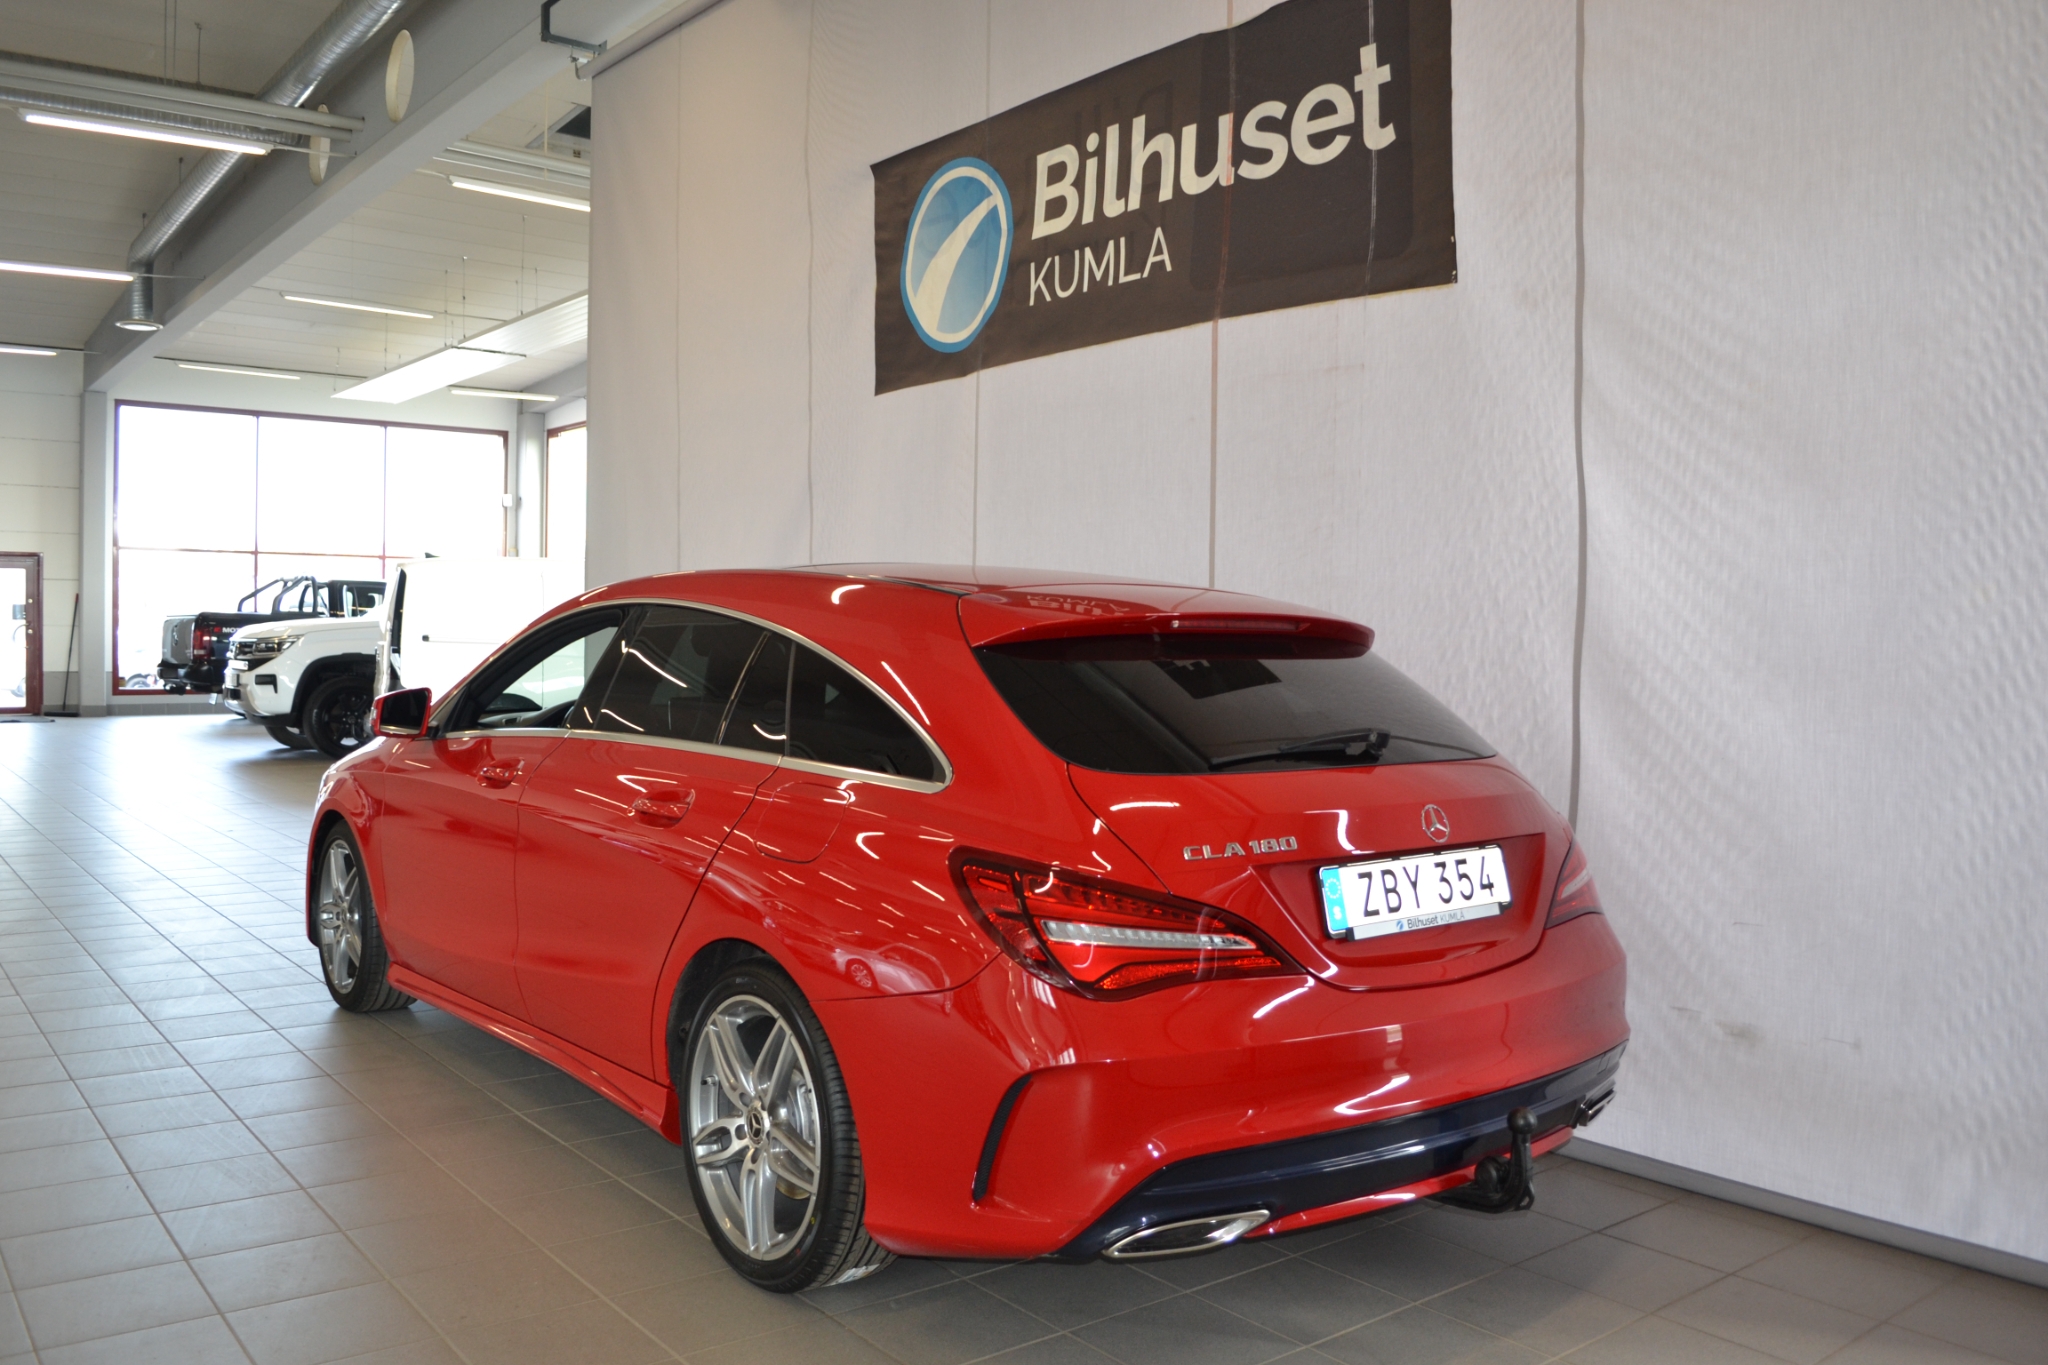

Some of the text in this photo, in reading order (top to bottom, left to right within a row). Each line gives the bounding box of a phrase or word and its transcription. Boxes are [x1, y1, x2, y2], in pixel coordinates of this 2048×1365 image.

[1031, 43, 1397, 241] Bilhuset
[1028, 226, 1173, 306] KUMLA
[1183, 836, 1298, 861] CLA 180
[1357, 856, 1494, 917] ZBY 354
[1407, 911, 1465, 929] Bilhuset KUMLA
